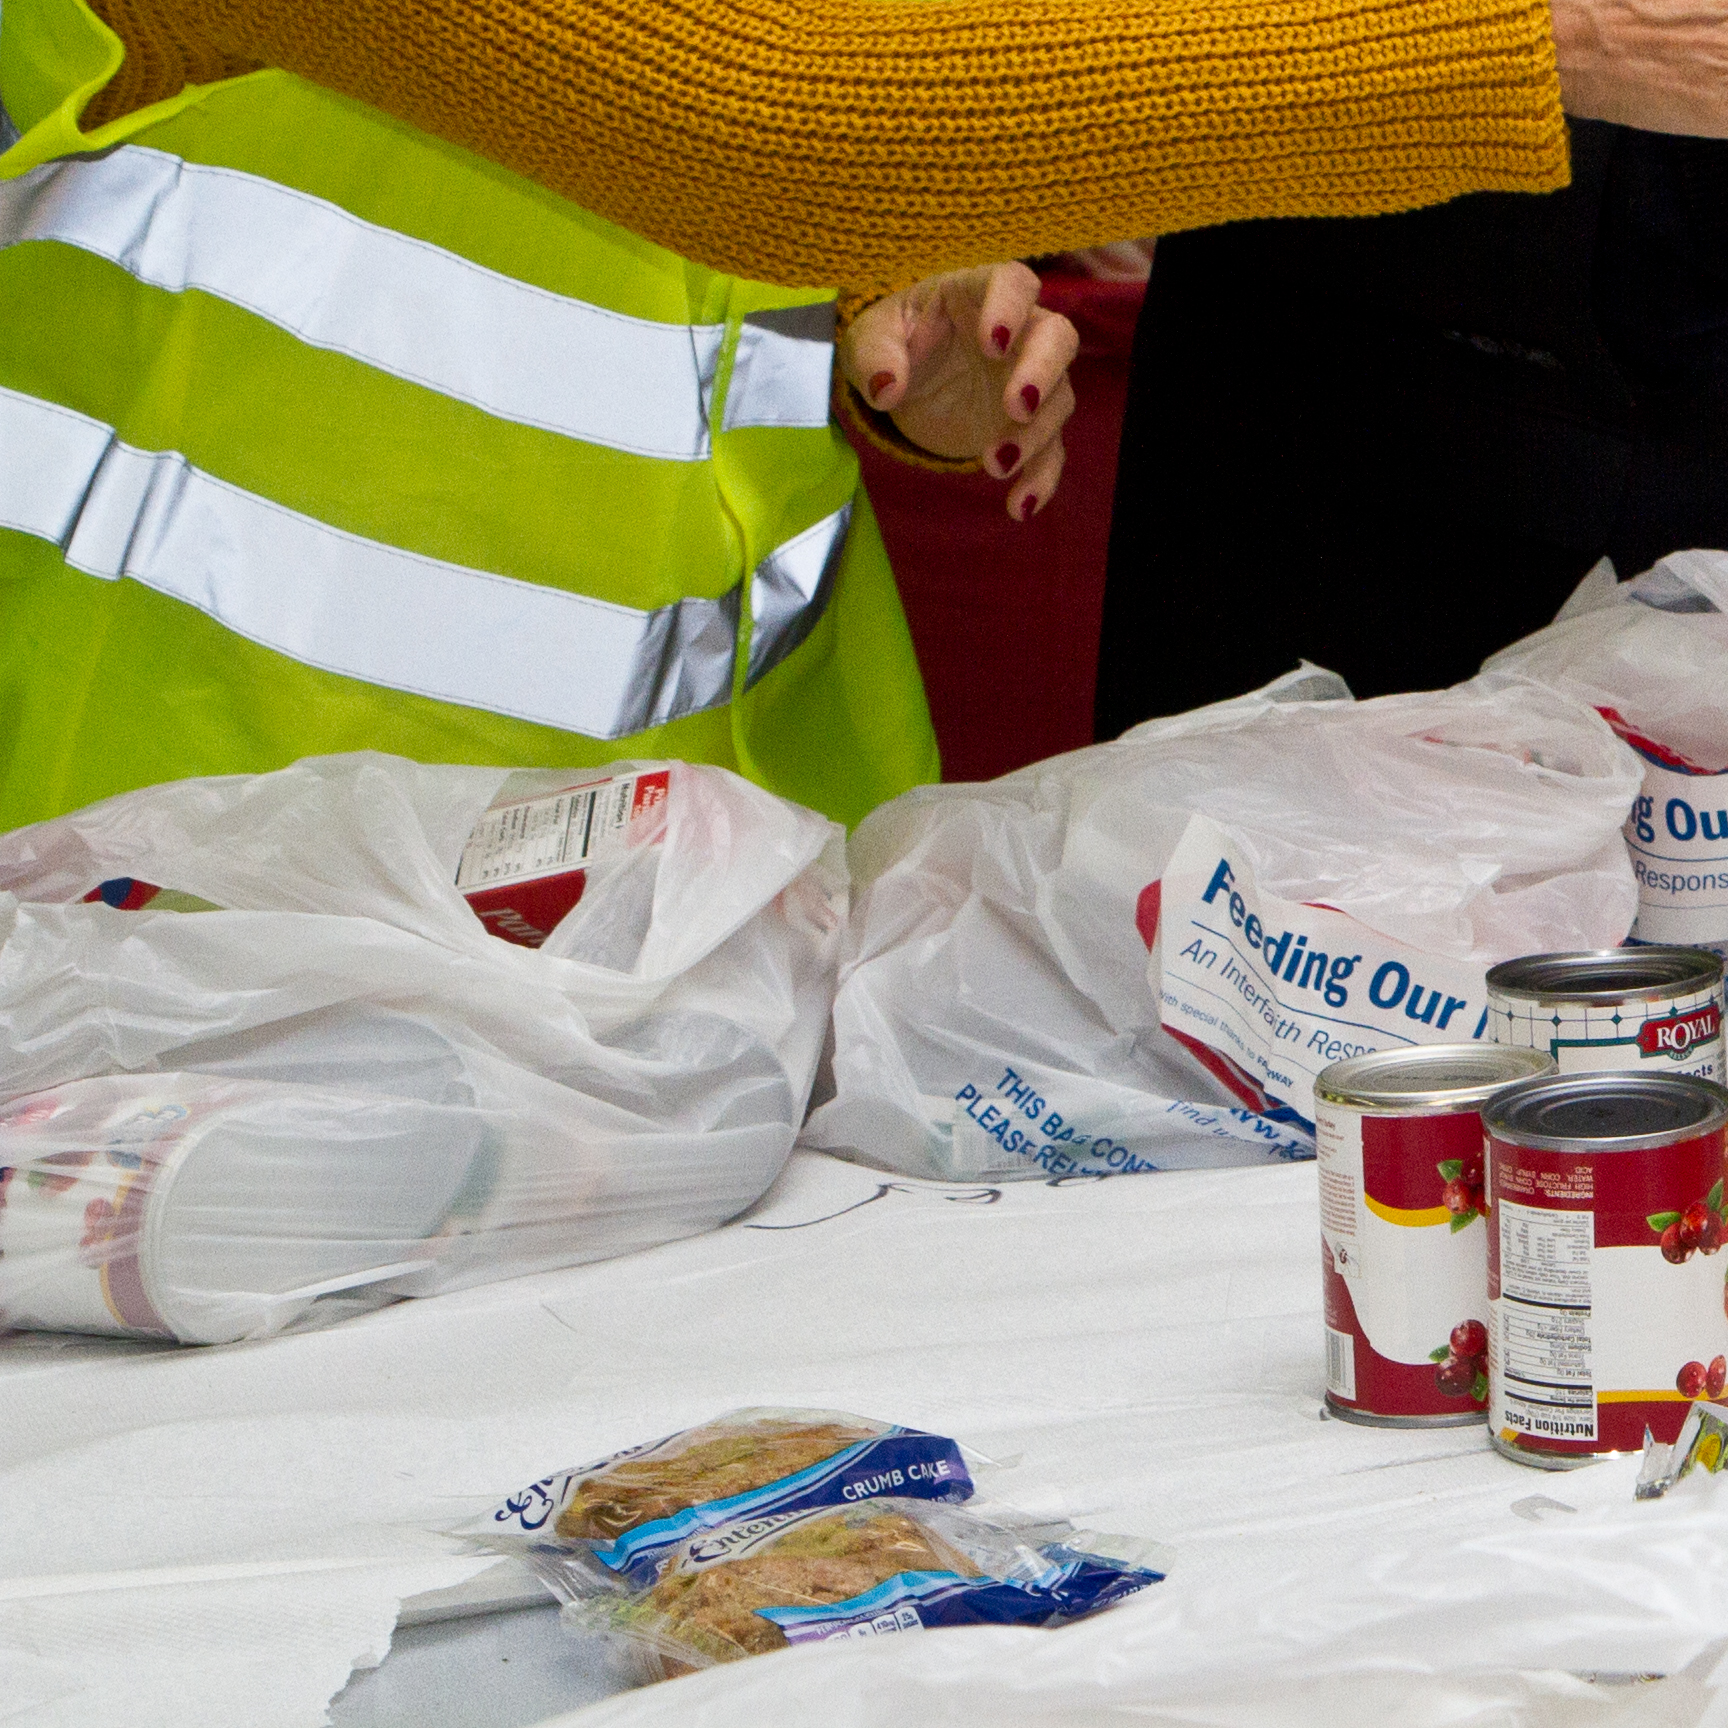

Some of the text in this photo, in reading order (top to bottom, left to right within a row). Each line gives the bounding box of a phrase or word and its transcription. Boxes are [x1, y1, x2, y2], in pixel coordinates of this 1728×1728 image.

[1201, 858, 1468, 1031] Feeding Our
[1179, 1001, 1219, 1028] special
[1180, 938, 1301, 1044] An Interfaith
[1657, 1014, 1716, 1050] ROYAL
[996, 1068, 1037, 1120] THIS
[955, 1082, 1034, 1155] PLEASE
[1504, 1410, 1595, 1437] Nutrition Facts
[842, 1459, 951, 1501] CRUMB CAKE
